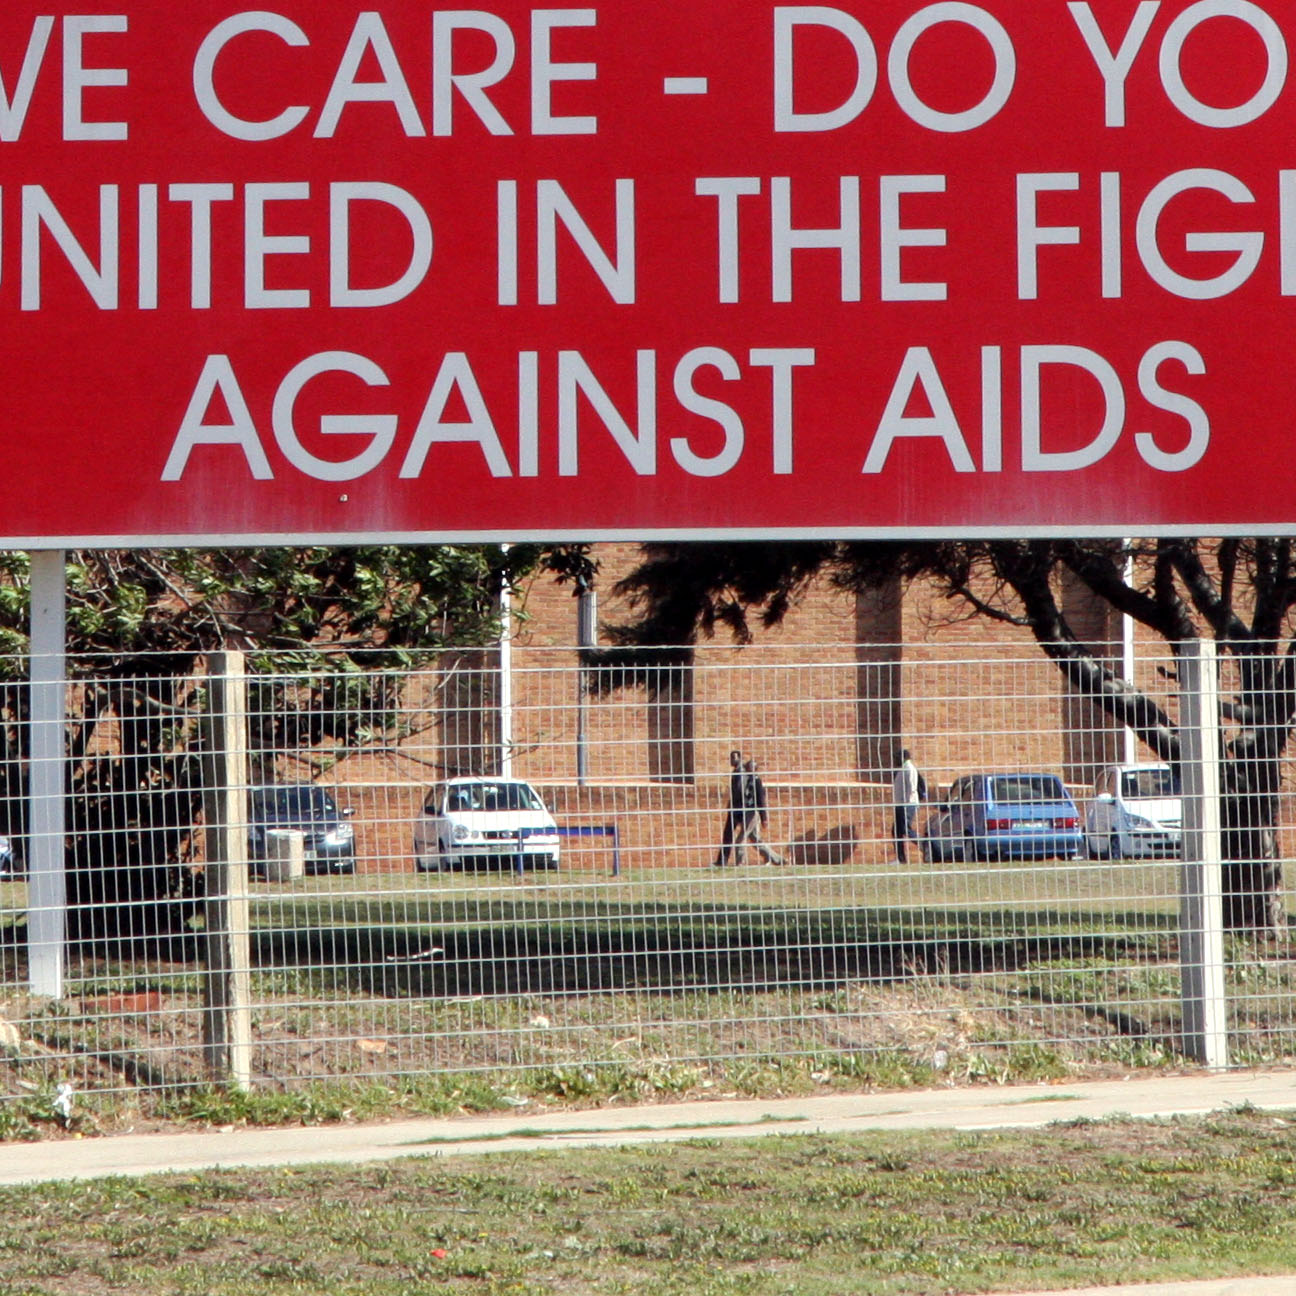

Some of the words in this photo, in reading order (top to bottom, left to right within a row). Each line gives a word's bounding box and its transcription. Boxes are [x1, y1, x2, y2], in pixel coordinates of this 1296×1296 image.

[192, 8, 597, 142] CARE
[774, 1, 1016, 134] DO
[497, 176, 636, 306] IN
[695, 174, 949, 304] THE
[160, 347, 815, 482] AGAINST
[861, 340, 1211, 474] AIDS
